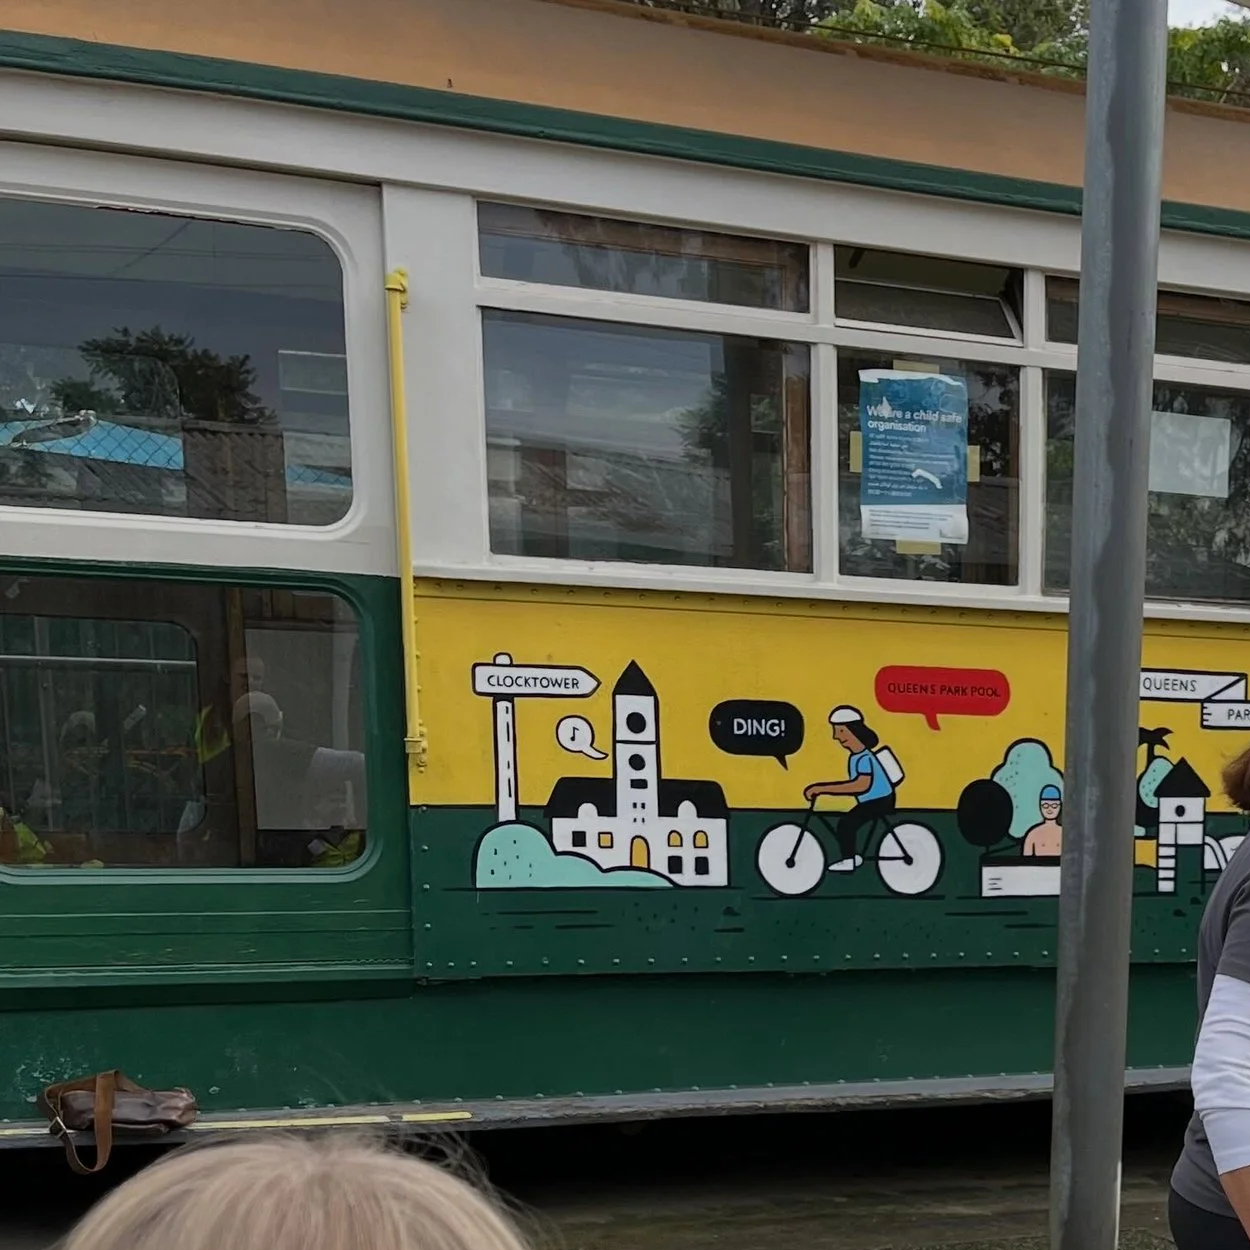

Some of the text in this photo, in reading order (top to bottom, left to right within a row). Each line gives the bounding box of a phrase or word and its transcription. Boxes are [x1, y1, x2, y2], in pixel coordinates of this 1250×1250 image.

[913, 410, 939, 421] child
[939, 411, 962, 423] safe
[867, 420, 927, 433] organisation
[487, 674, 580, 690] CLOCKTOWER
[887, 682, 1001, 698] QUEENS PARK POOL
[1142, 676, 1198, 693] QUEENS
[733, 718, 786, 738] DING!
